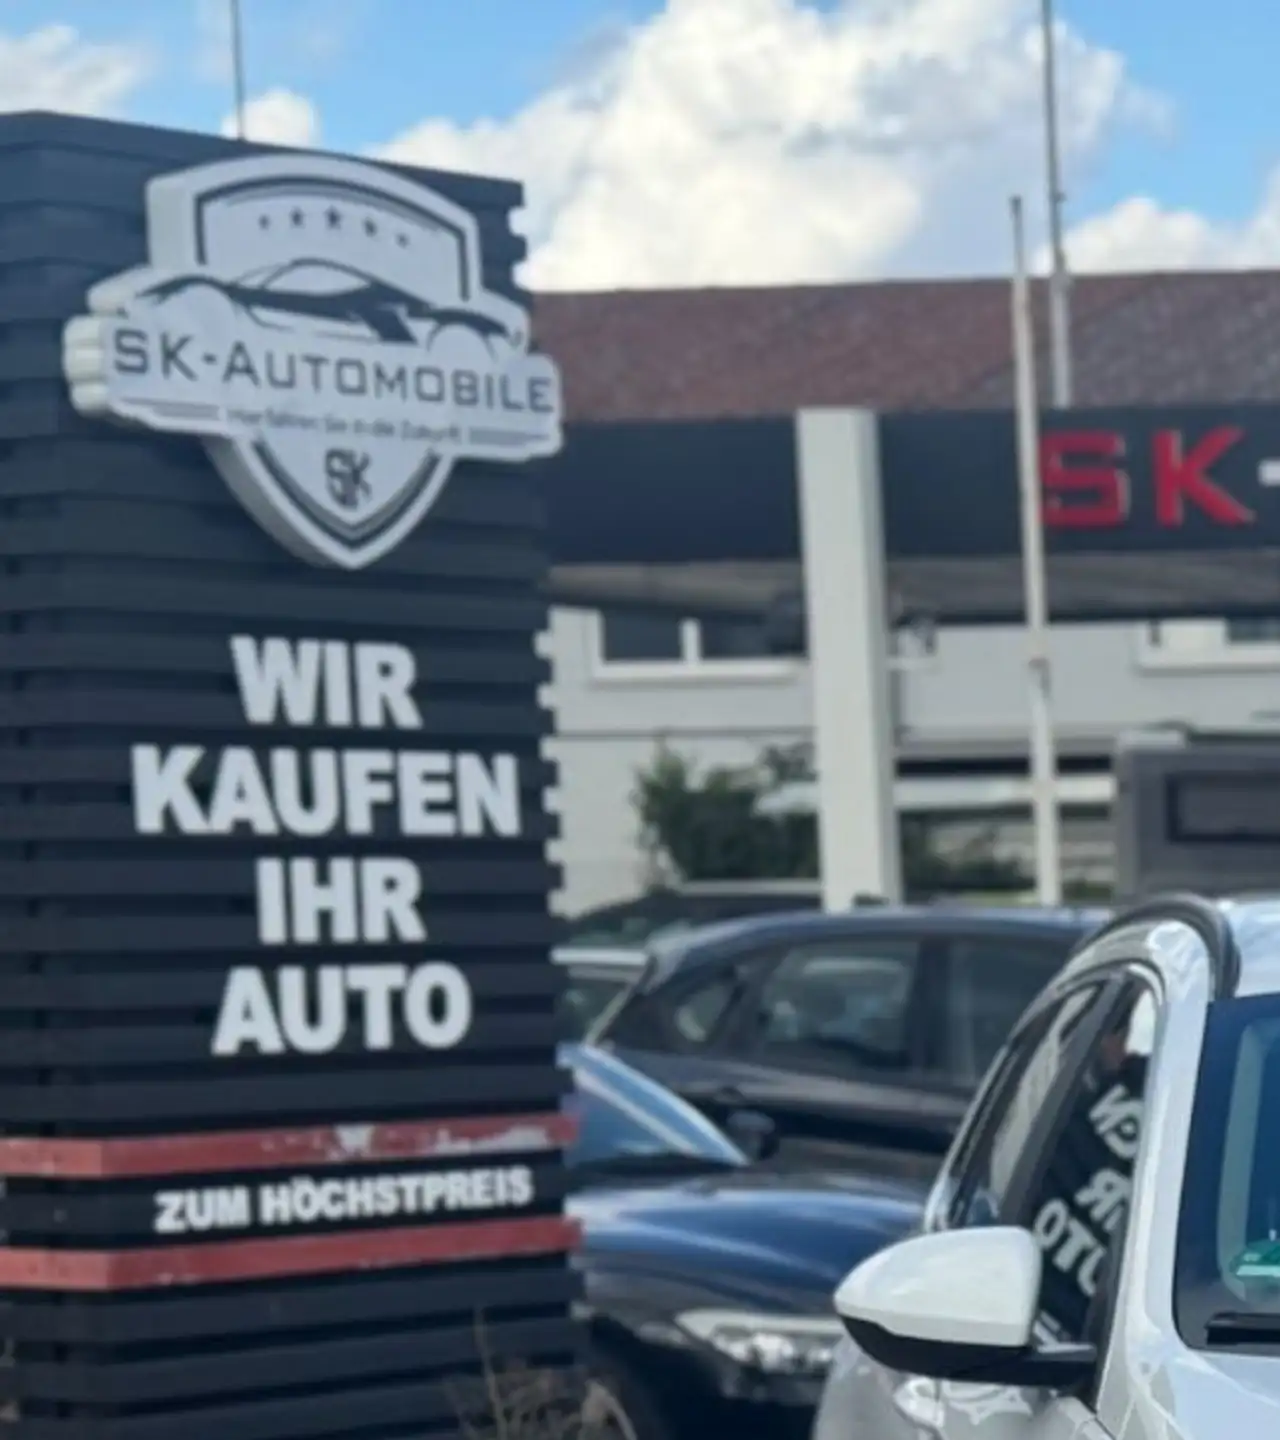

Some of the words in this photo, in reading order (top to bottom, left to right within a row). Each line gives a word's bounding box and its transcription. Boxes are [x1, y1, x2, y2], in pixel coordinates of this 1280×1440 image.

[112, 326, 556, 415] SK-AUTOMOBILE
[230, 635, 424, 730] WIR
[131, 744, 522, 836] KAUFEN
[256, 856, 428, 945] IHR
[211, 961, 473, 1056] AUTO
[154, 1186, 252, 1234] ZUM
[260, 1164, 533, 1227] HÖCHSTPREIS
